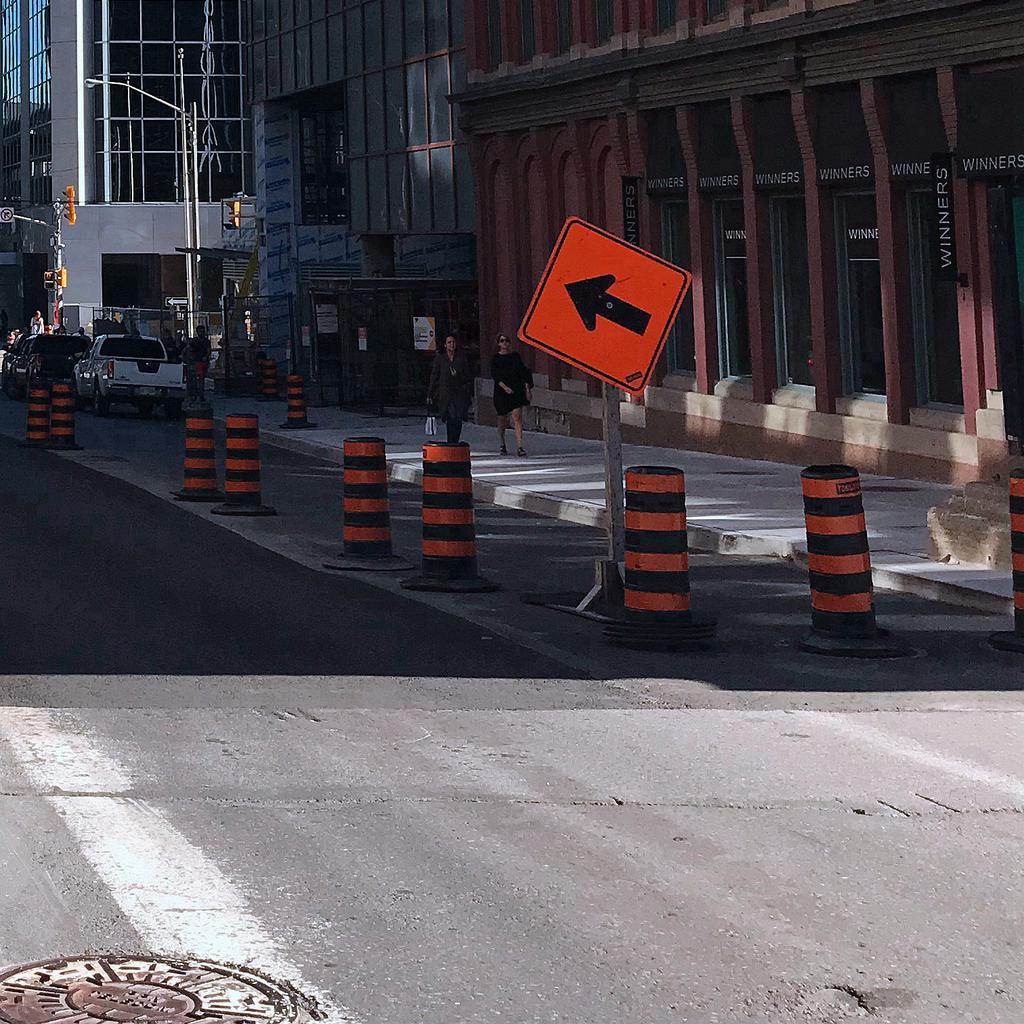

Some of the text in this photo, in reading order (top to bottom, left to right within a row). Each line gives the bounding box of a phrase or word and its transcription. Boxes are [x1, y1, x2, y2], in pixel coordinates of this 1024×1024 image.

[891, 161, 931, 176] WINNE
[963, 154, 1024, 171] WINNERS
[755, 171, 800, 185] WINNERS
[820, 165, 870, 180] WINNERS
[648, 176, 684, 189] WINNERS
[699, 174, 739, 188] WINNERS
[624, 184, 636, 244] NNERS
[936, 167, 952, 269] WINNERS
[725, 229, 747, 240] WINN
[848, 228, 878, 240] WINNE
